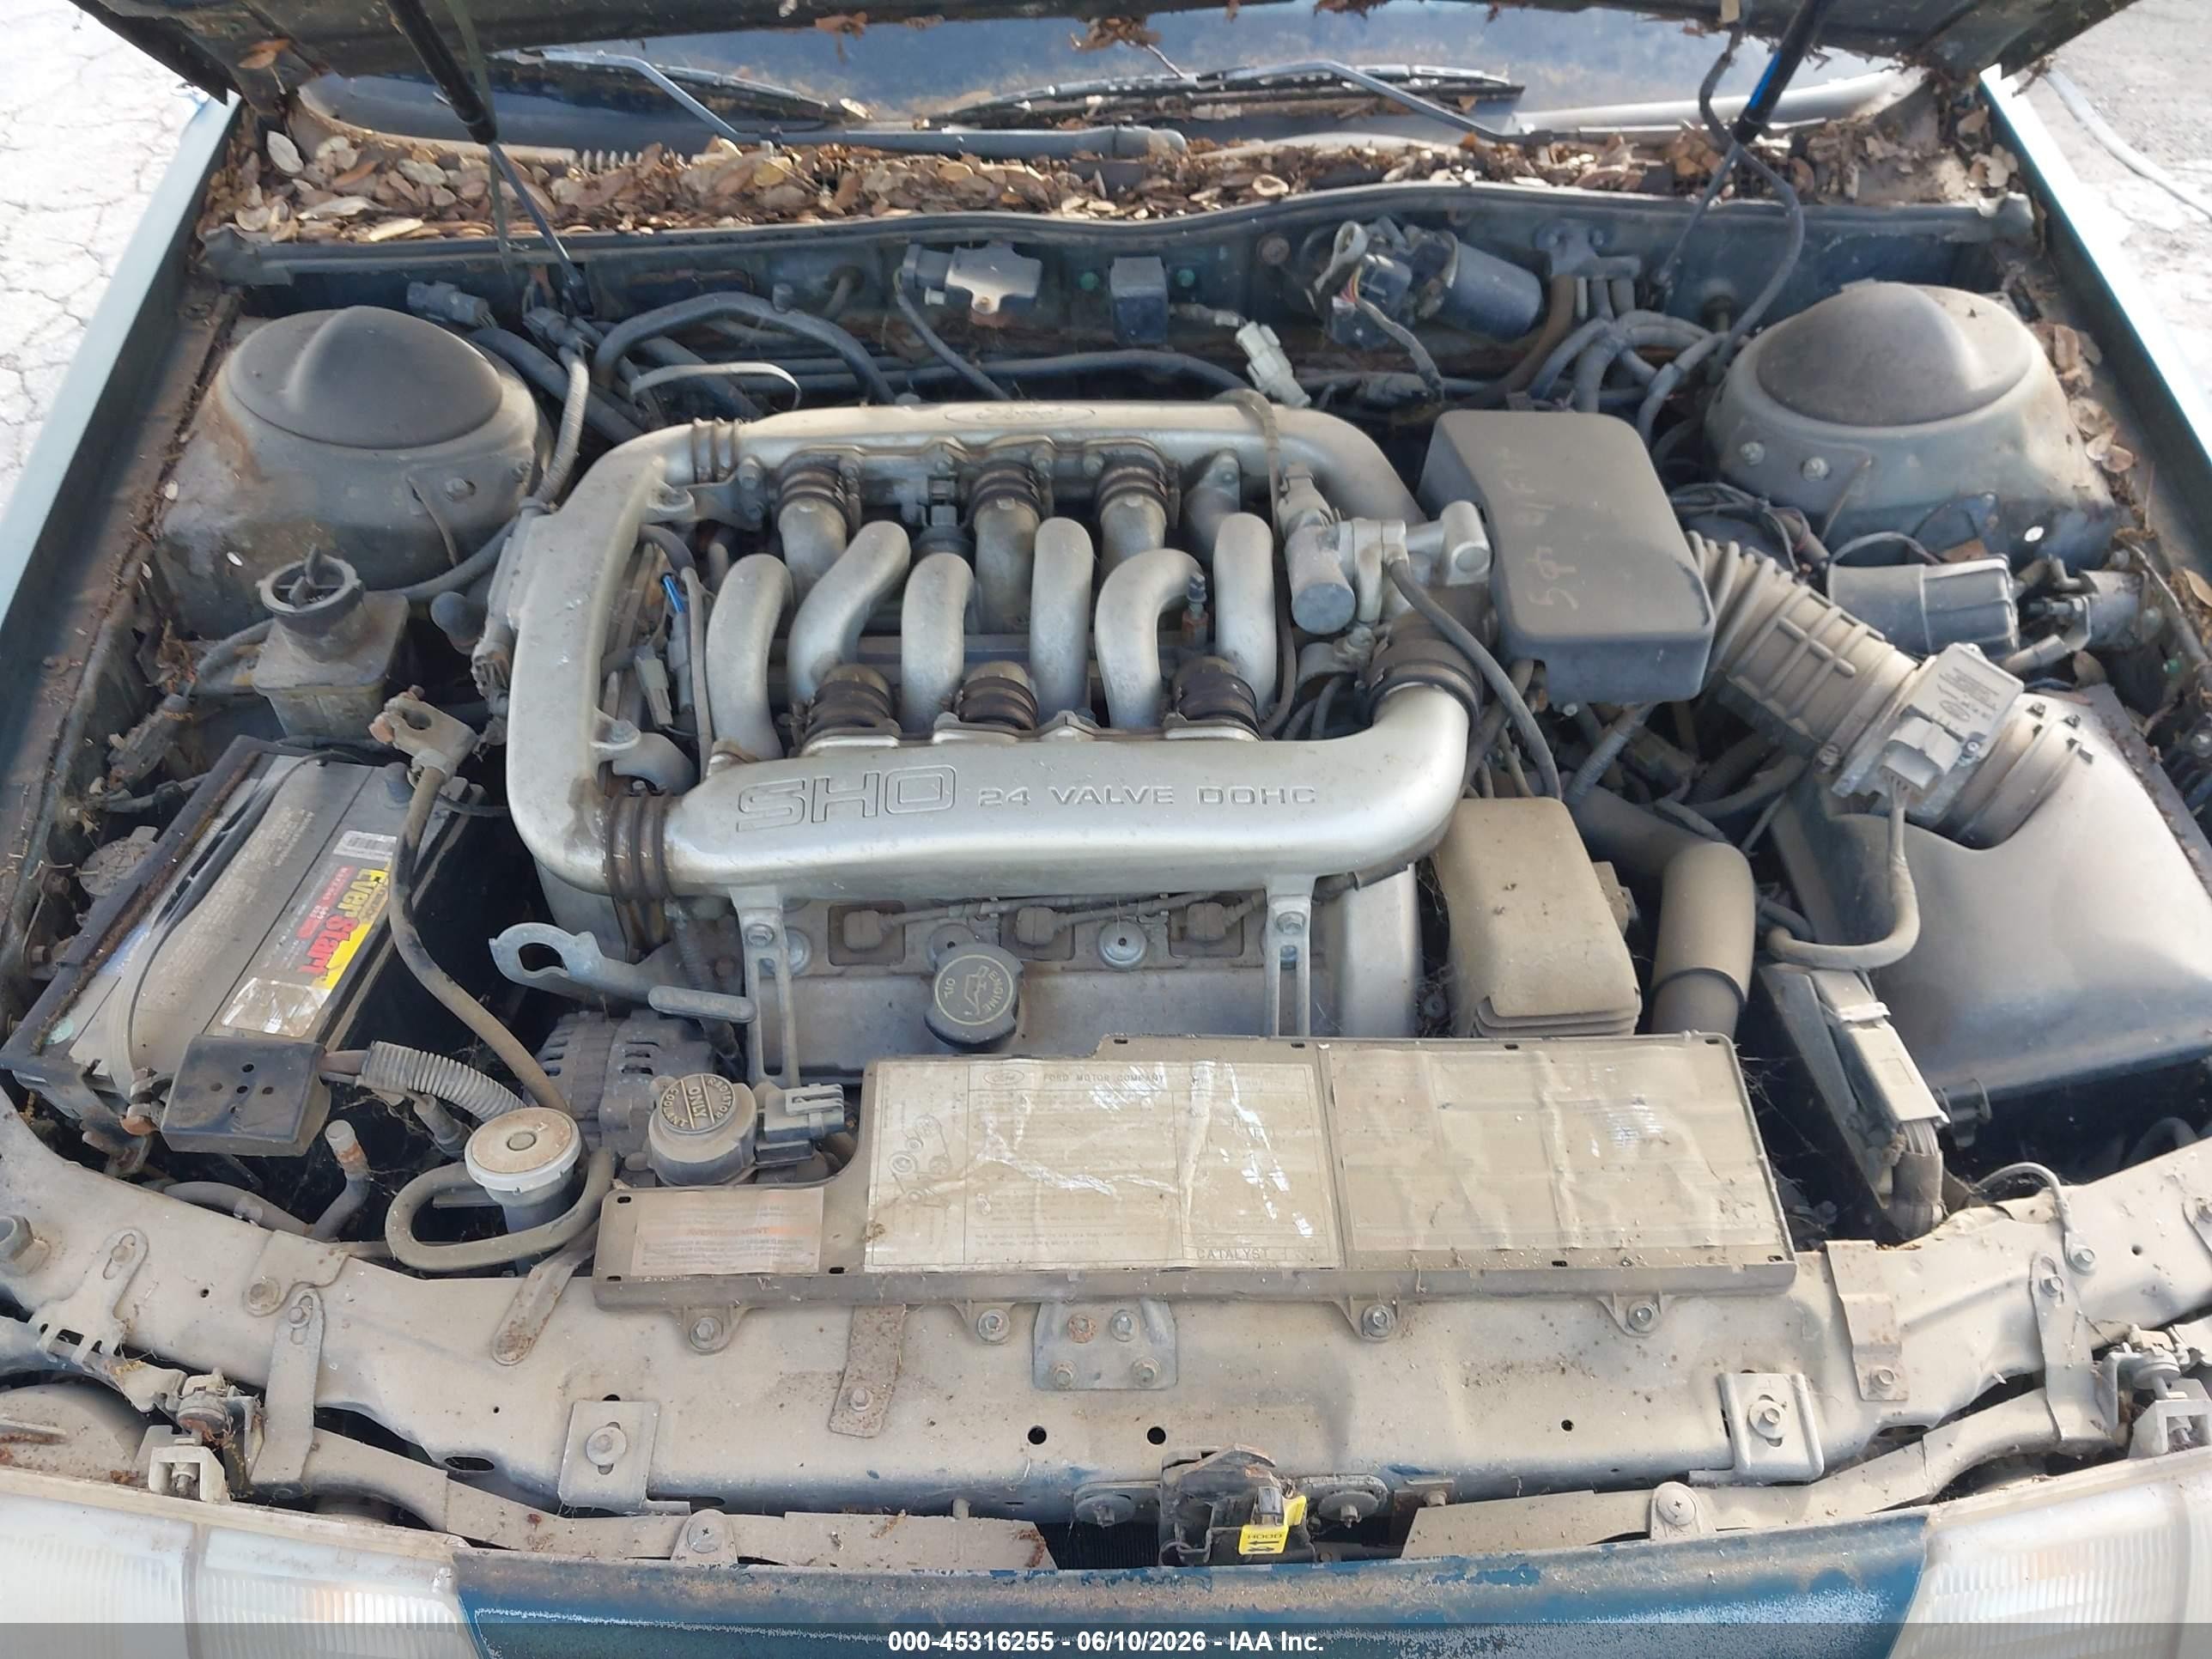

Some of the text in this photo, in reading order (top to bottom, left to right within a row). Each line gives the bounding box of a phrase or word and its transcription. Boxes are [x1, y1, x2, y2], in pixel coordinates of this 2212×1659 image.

[736, 764, 1316, 832] SHO 24 VALVE DOHC
[943, 977, 956, 1000] OIL
[982, 969, 1004, 1011] ENGINE
[1043, 1073, 1164, 1082] FORD MOTOR COMPANY
[663, 1087, 689, 1127] COOLANT
[688, 1086, 708, 1117] ONLY
[707, 1077, 732, 1119] RADIATOR
[1196, 1248, 1269, 1260] CATALYST
